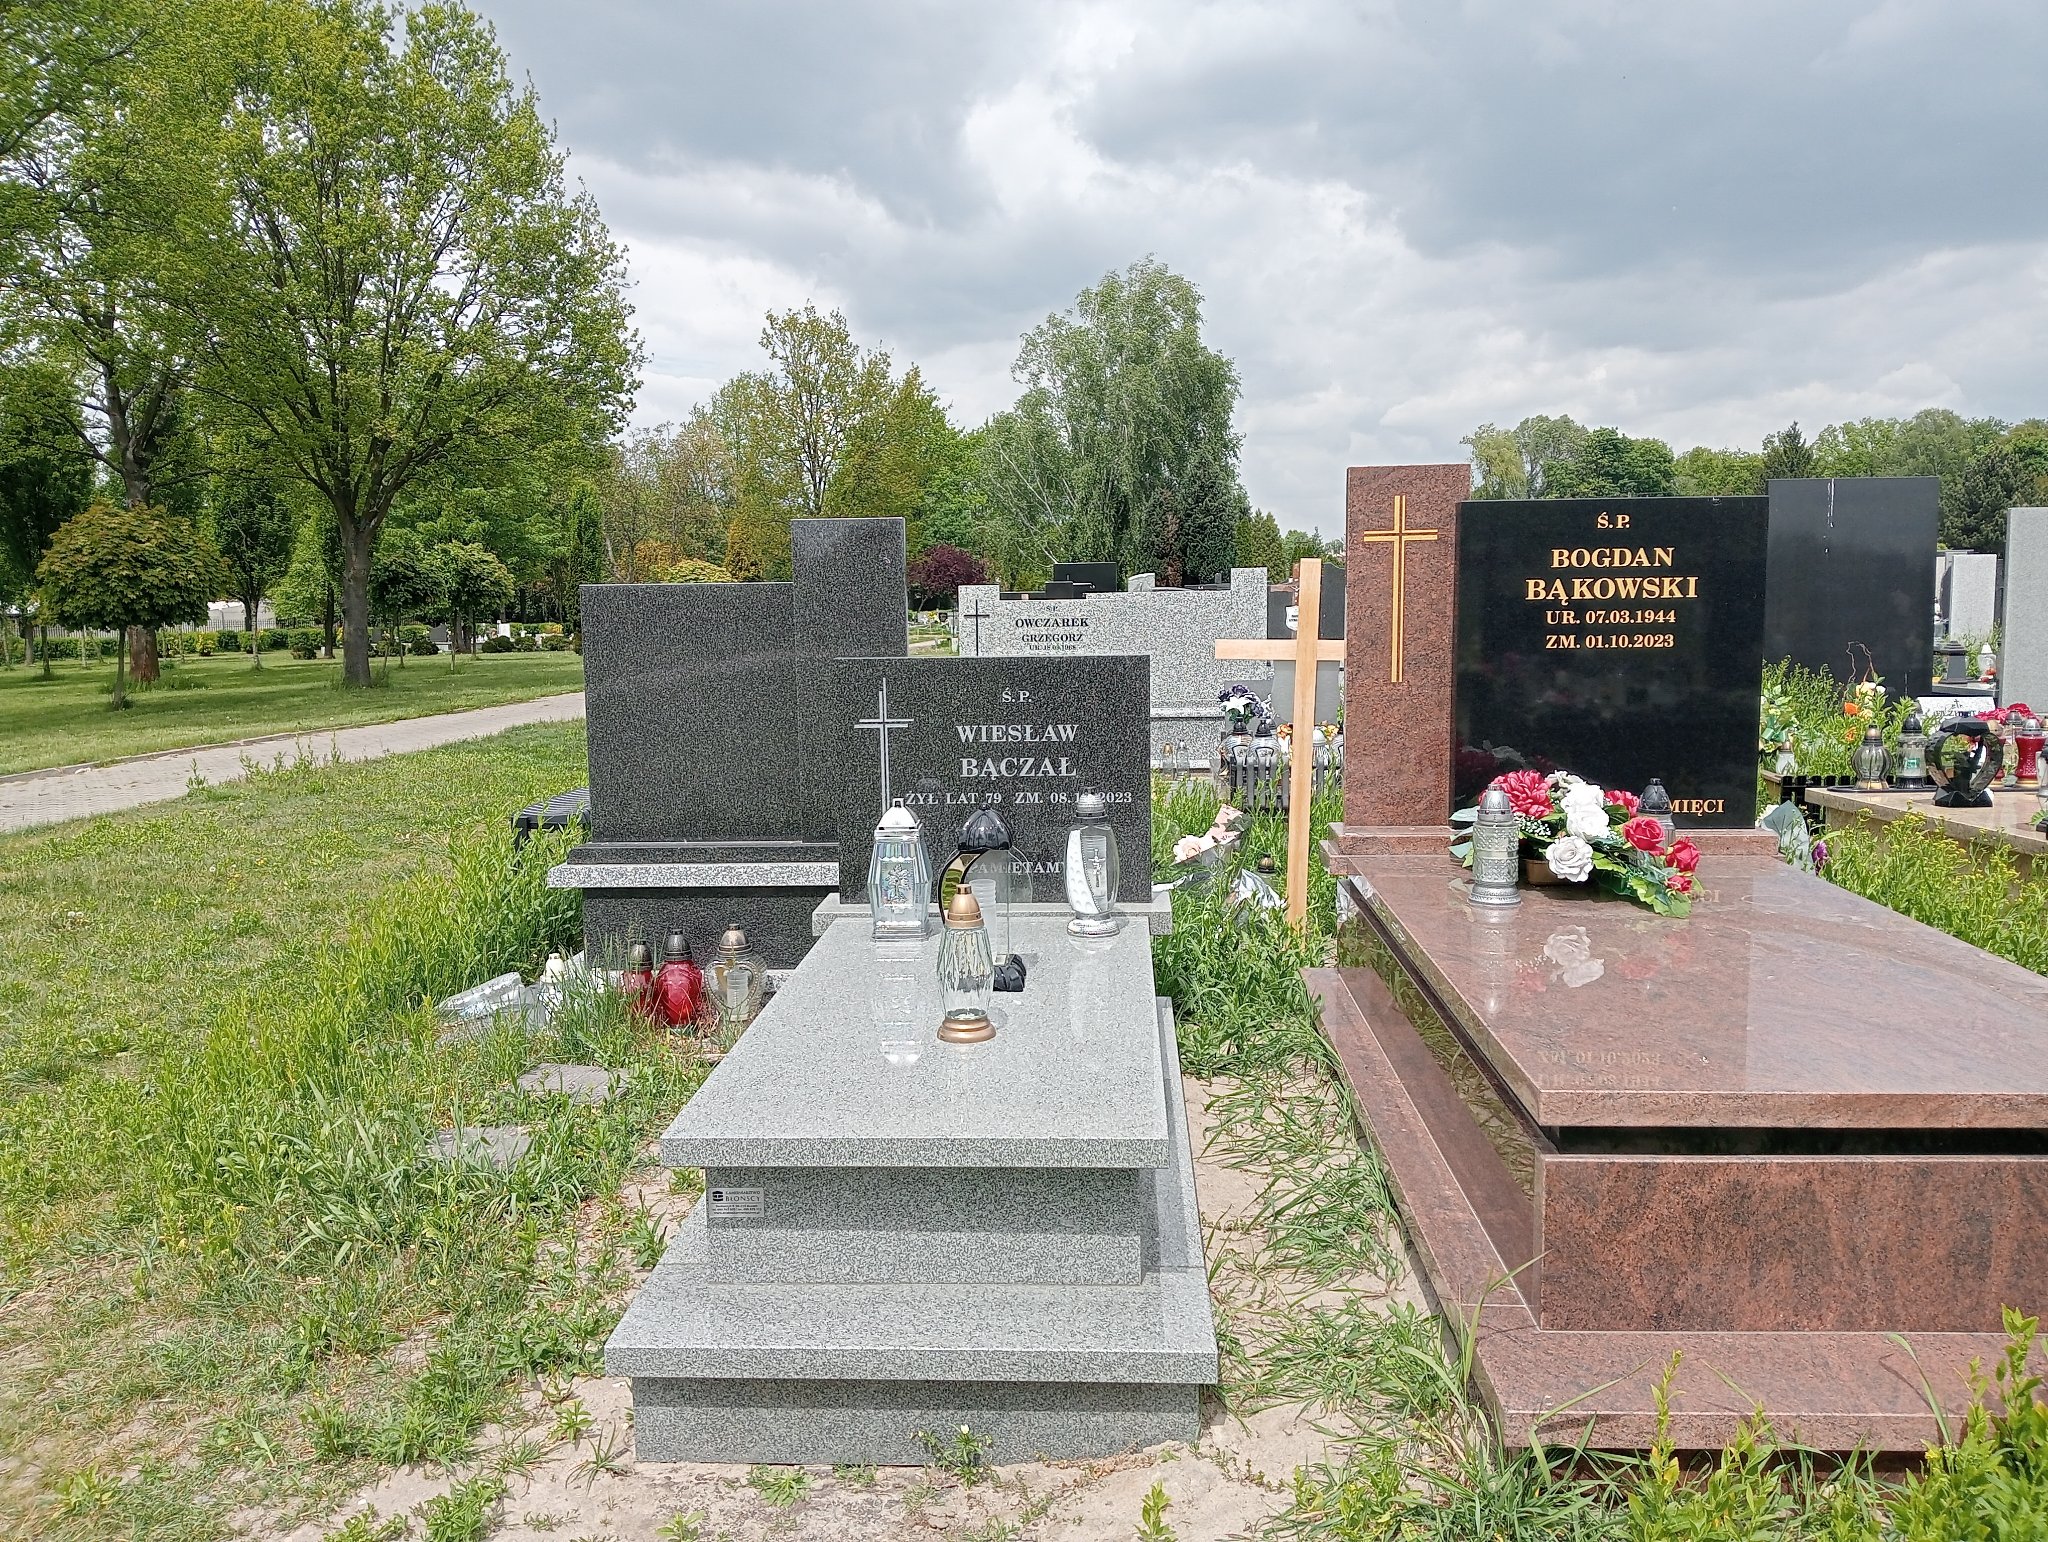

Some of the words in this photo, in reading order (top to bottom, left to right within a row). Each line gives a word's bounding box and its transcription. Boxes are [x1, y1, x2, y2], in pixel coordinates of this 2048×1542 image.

[1550, 547, 1676, 569] BOGDAN
[1525, 576, 1699, 606] BĄKOWSKI
[1015, 617, 1089, 628] OWCZAREK
[1546, 610, 1581, 625] UR.
[1585, 609, 1676, 624] 07.03.1944
[1021, 633, 1084, 643] GRZEGORZ
[1545, 634, 1581, 649] ZM.
[1585, 634, 1675, 649] 01.10.2023
[955, 723, 1079, 743] WIESŁAW
[959, 757, 1077, 780] BĄCZAŁ
[905, 790, 939, 805] ŻYŁ
[946, 792, 979, 804] LAT
[986, 791, 1002, 804] 79
[1014, 791, 1043, 804] ZM.
[1050, 791, 1132, 804] 08.12023
[1670, 799, 1725, 816] MIĘCI
